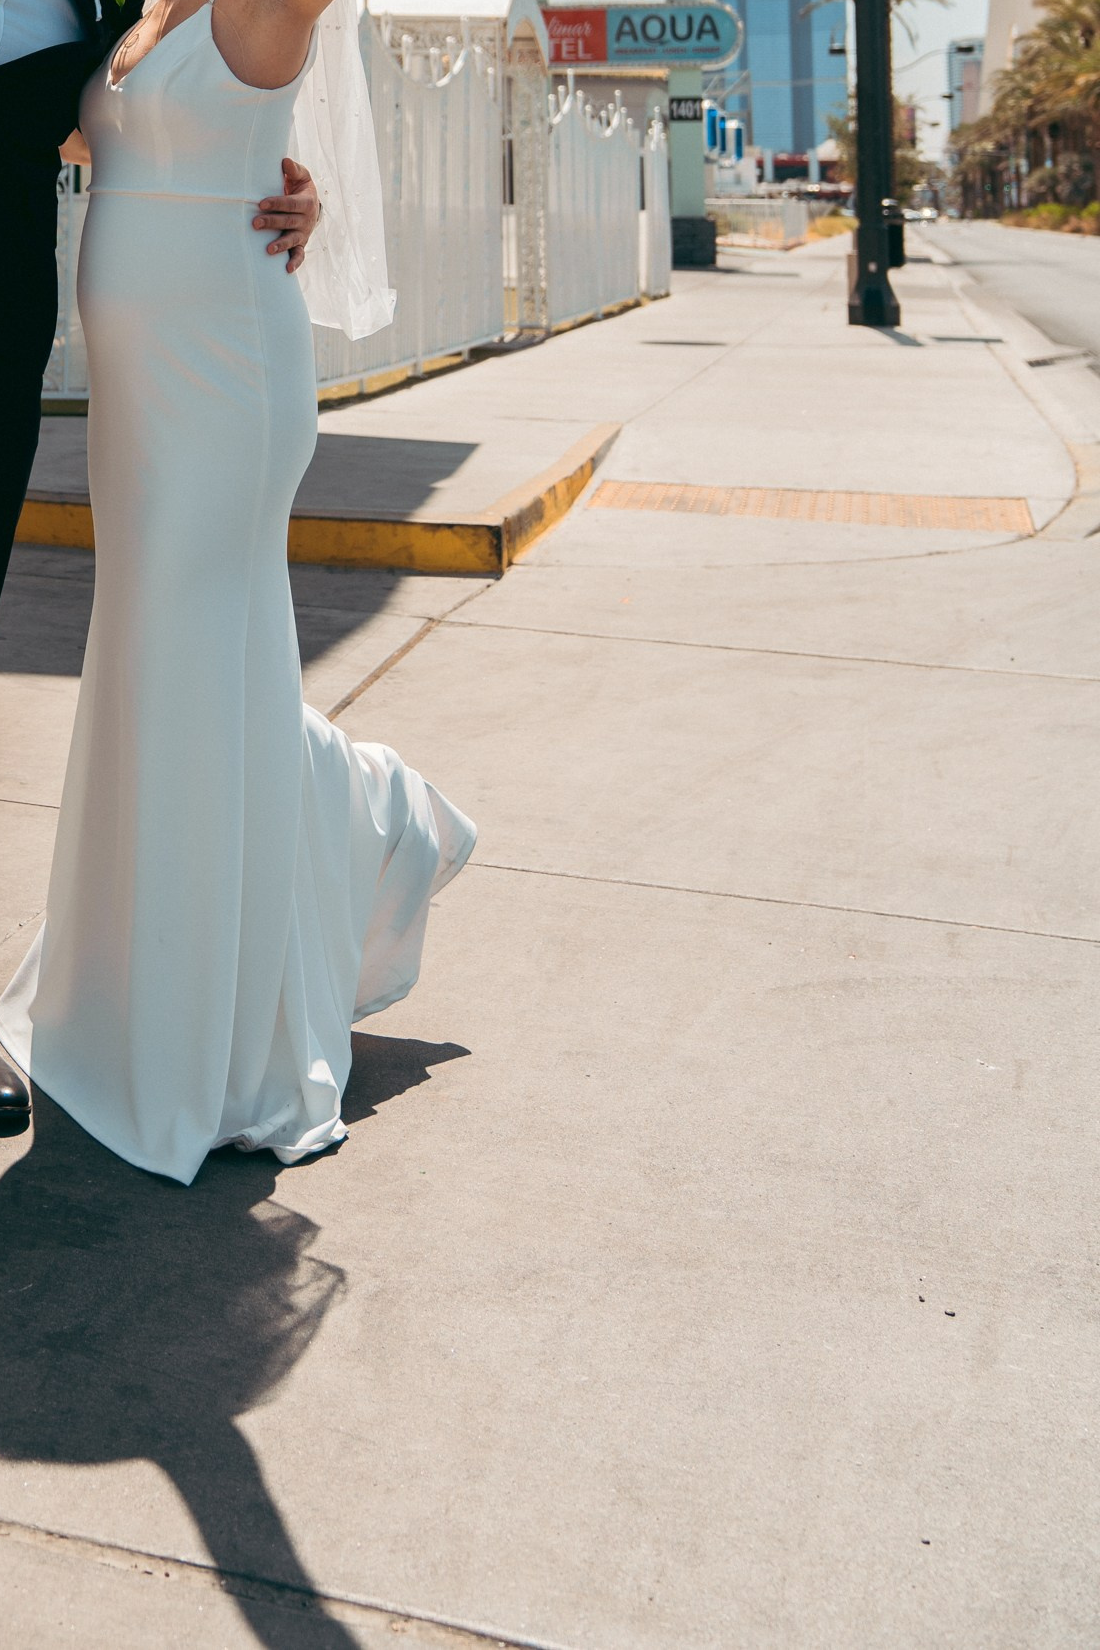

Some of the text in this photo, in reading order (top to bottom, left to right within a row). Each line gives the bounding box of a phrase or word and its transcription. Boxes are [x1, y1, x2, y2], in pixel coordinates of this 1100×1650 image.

[548, 16, 592, 37] limar
[615, 14, 720, 45] AQUA
[548, 38, 593, 60] TEL
[671, 100, 701, 118] 1401
